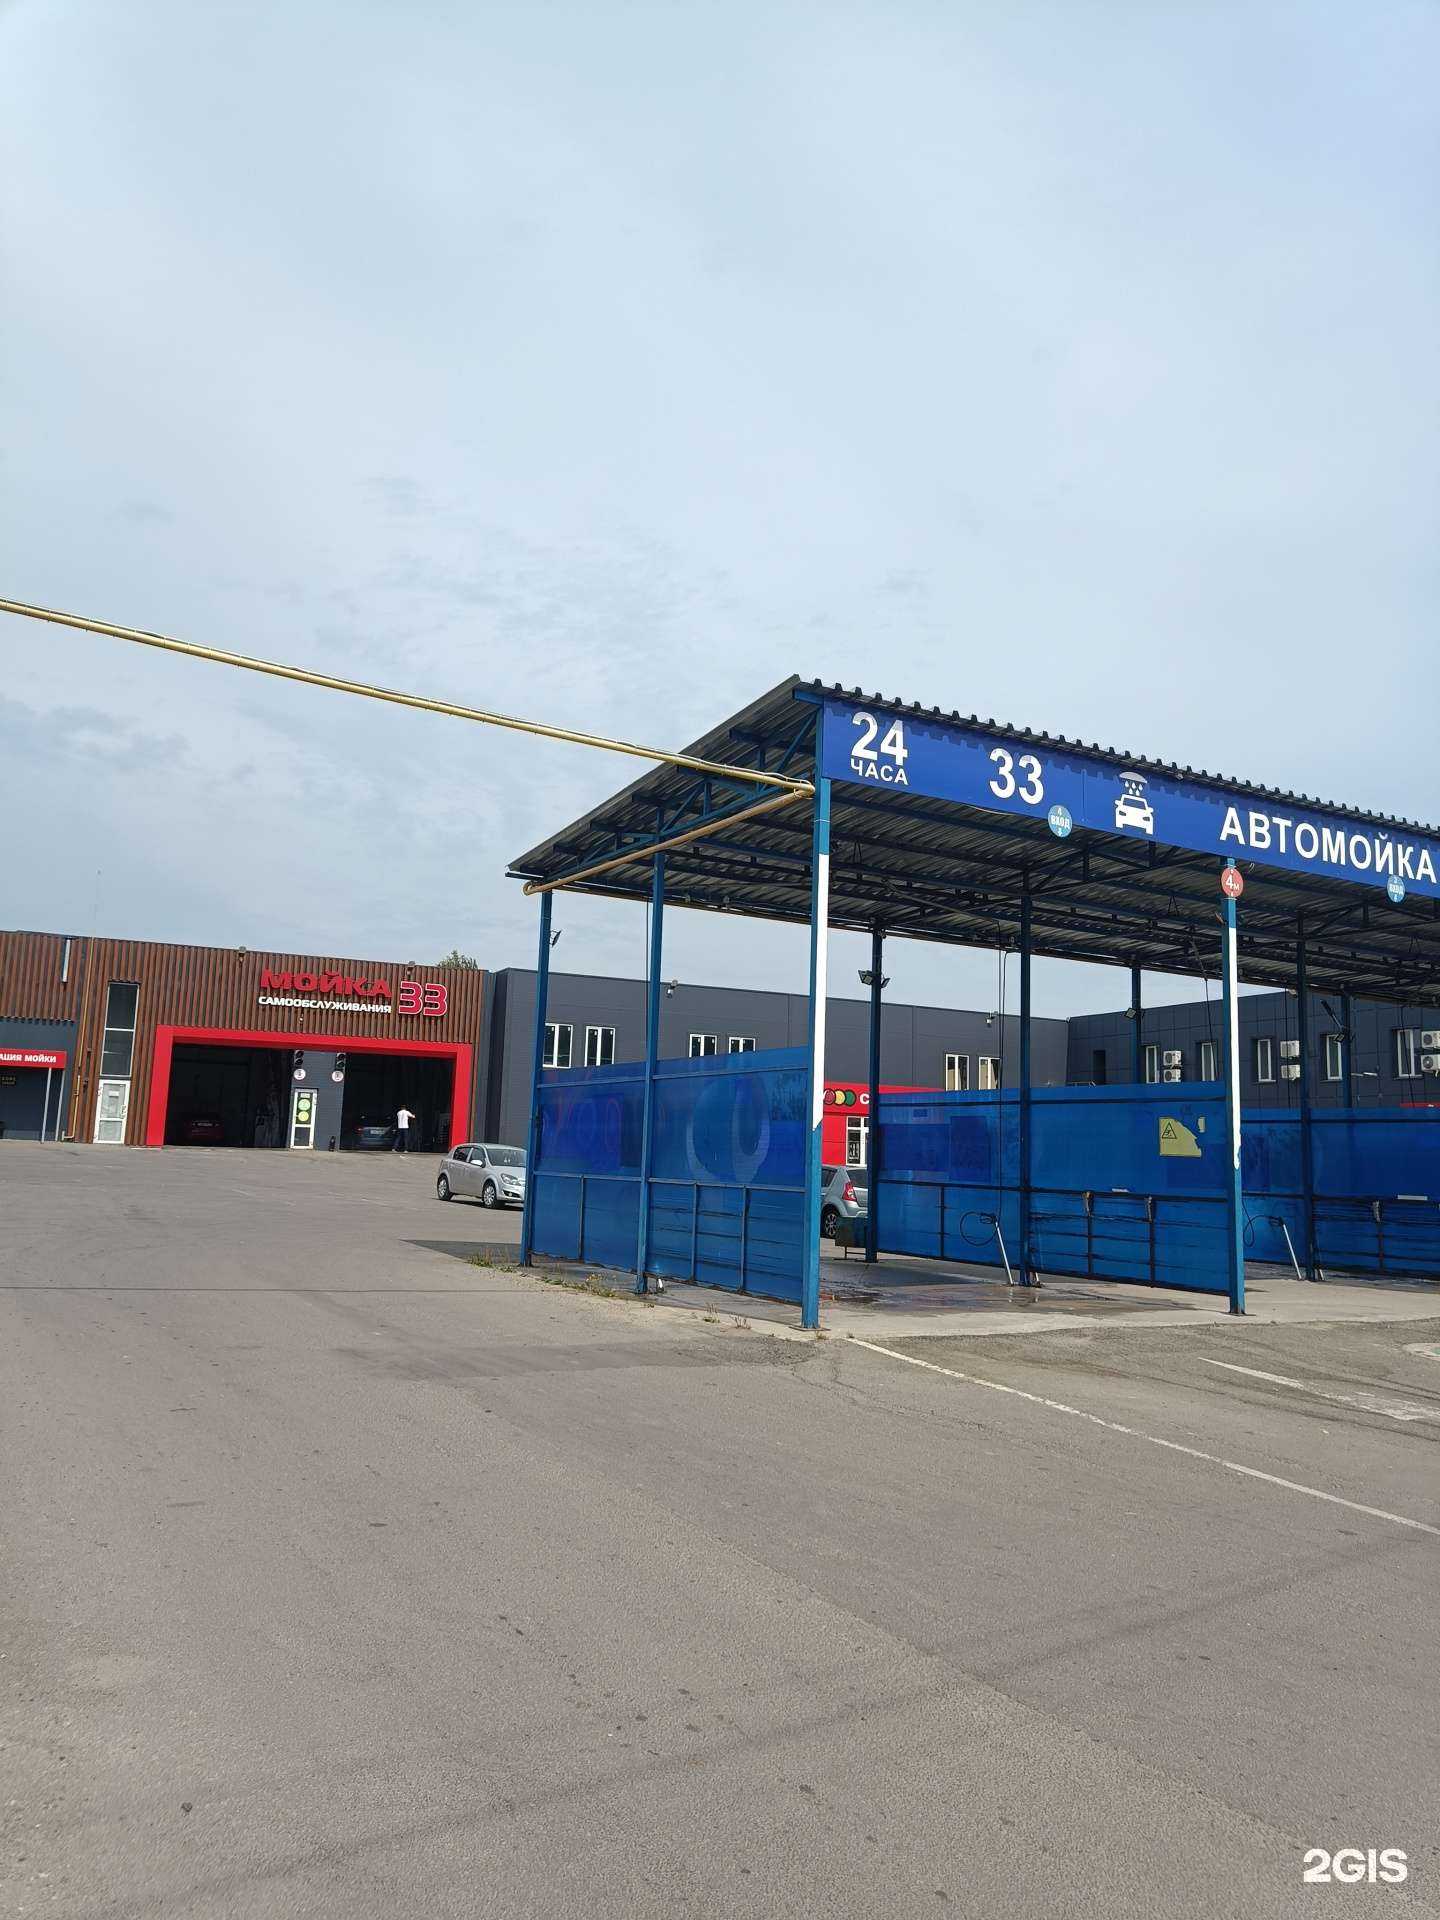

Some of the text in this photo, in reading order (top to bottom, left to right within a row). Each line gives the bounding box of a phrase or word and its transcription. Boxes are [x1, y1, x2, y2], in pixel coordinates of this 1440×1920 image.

[851, 711, 908, 766] 24
[850, 758, 909, 786] ЧАСА
[989, 748, 1044, 805] 33
[1219, 806, 1437, 884] АВТОМОЙКА
[260, 968, 392, 998] МОЙКА
[398, 980, 448, 1017] 33
[258, 996, 392, 1014] САМООБСЛУЖИВАНИЯ
[24, 1054, 57, 1063] МОЙКИ
